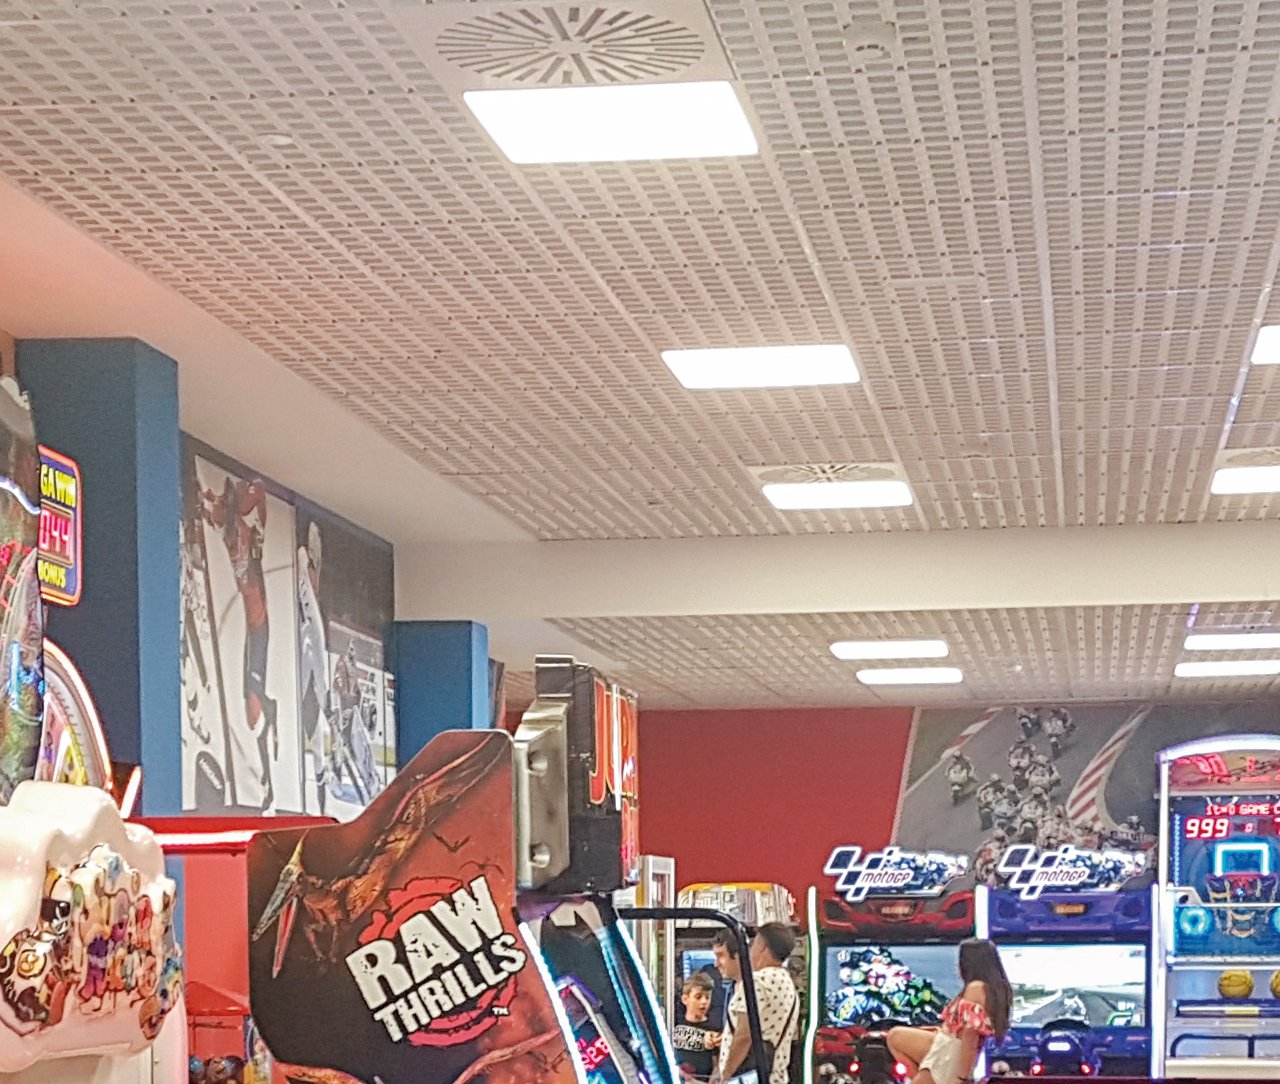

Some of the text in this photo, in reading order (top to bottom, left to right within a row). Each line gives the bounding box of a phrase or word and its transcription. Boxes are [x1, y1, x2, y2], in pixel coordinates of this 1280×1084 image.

[1186, 818, 1229, 838] 999
[1239, 803, 1269, 815] GAME
[345, 875, 504, 1010] RAW
[373, 934, 527, 1042] THRILLS
